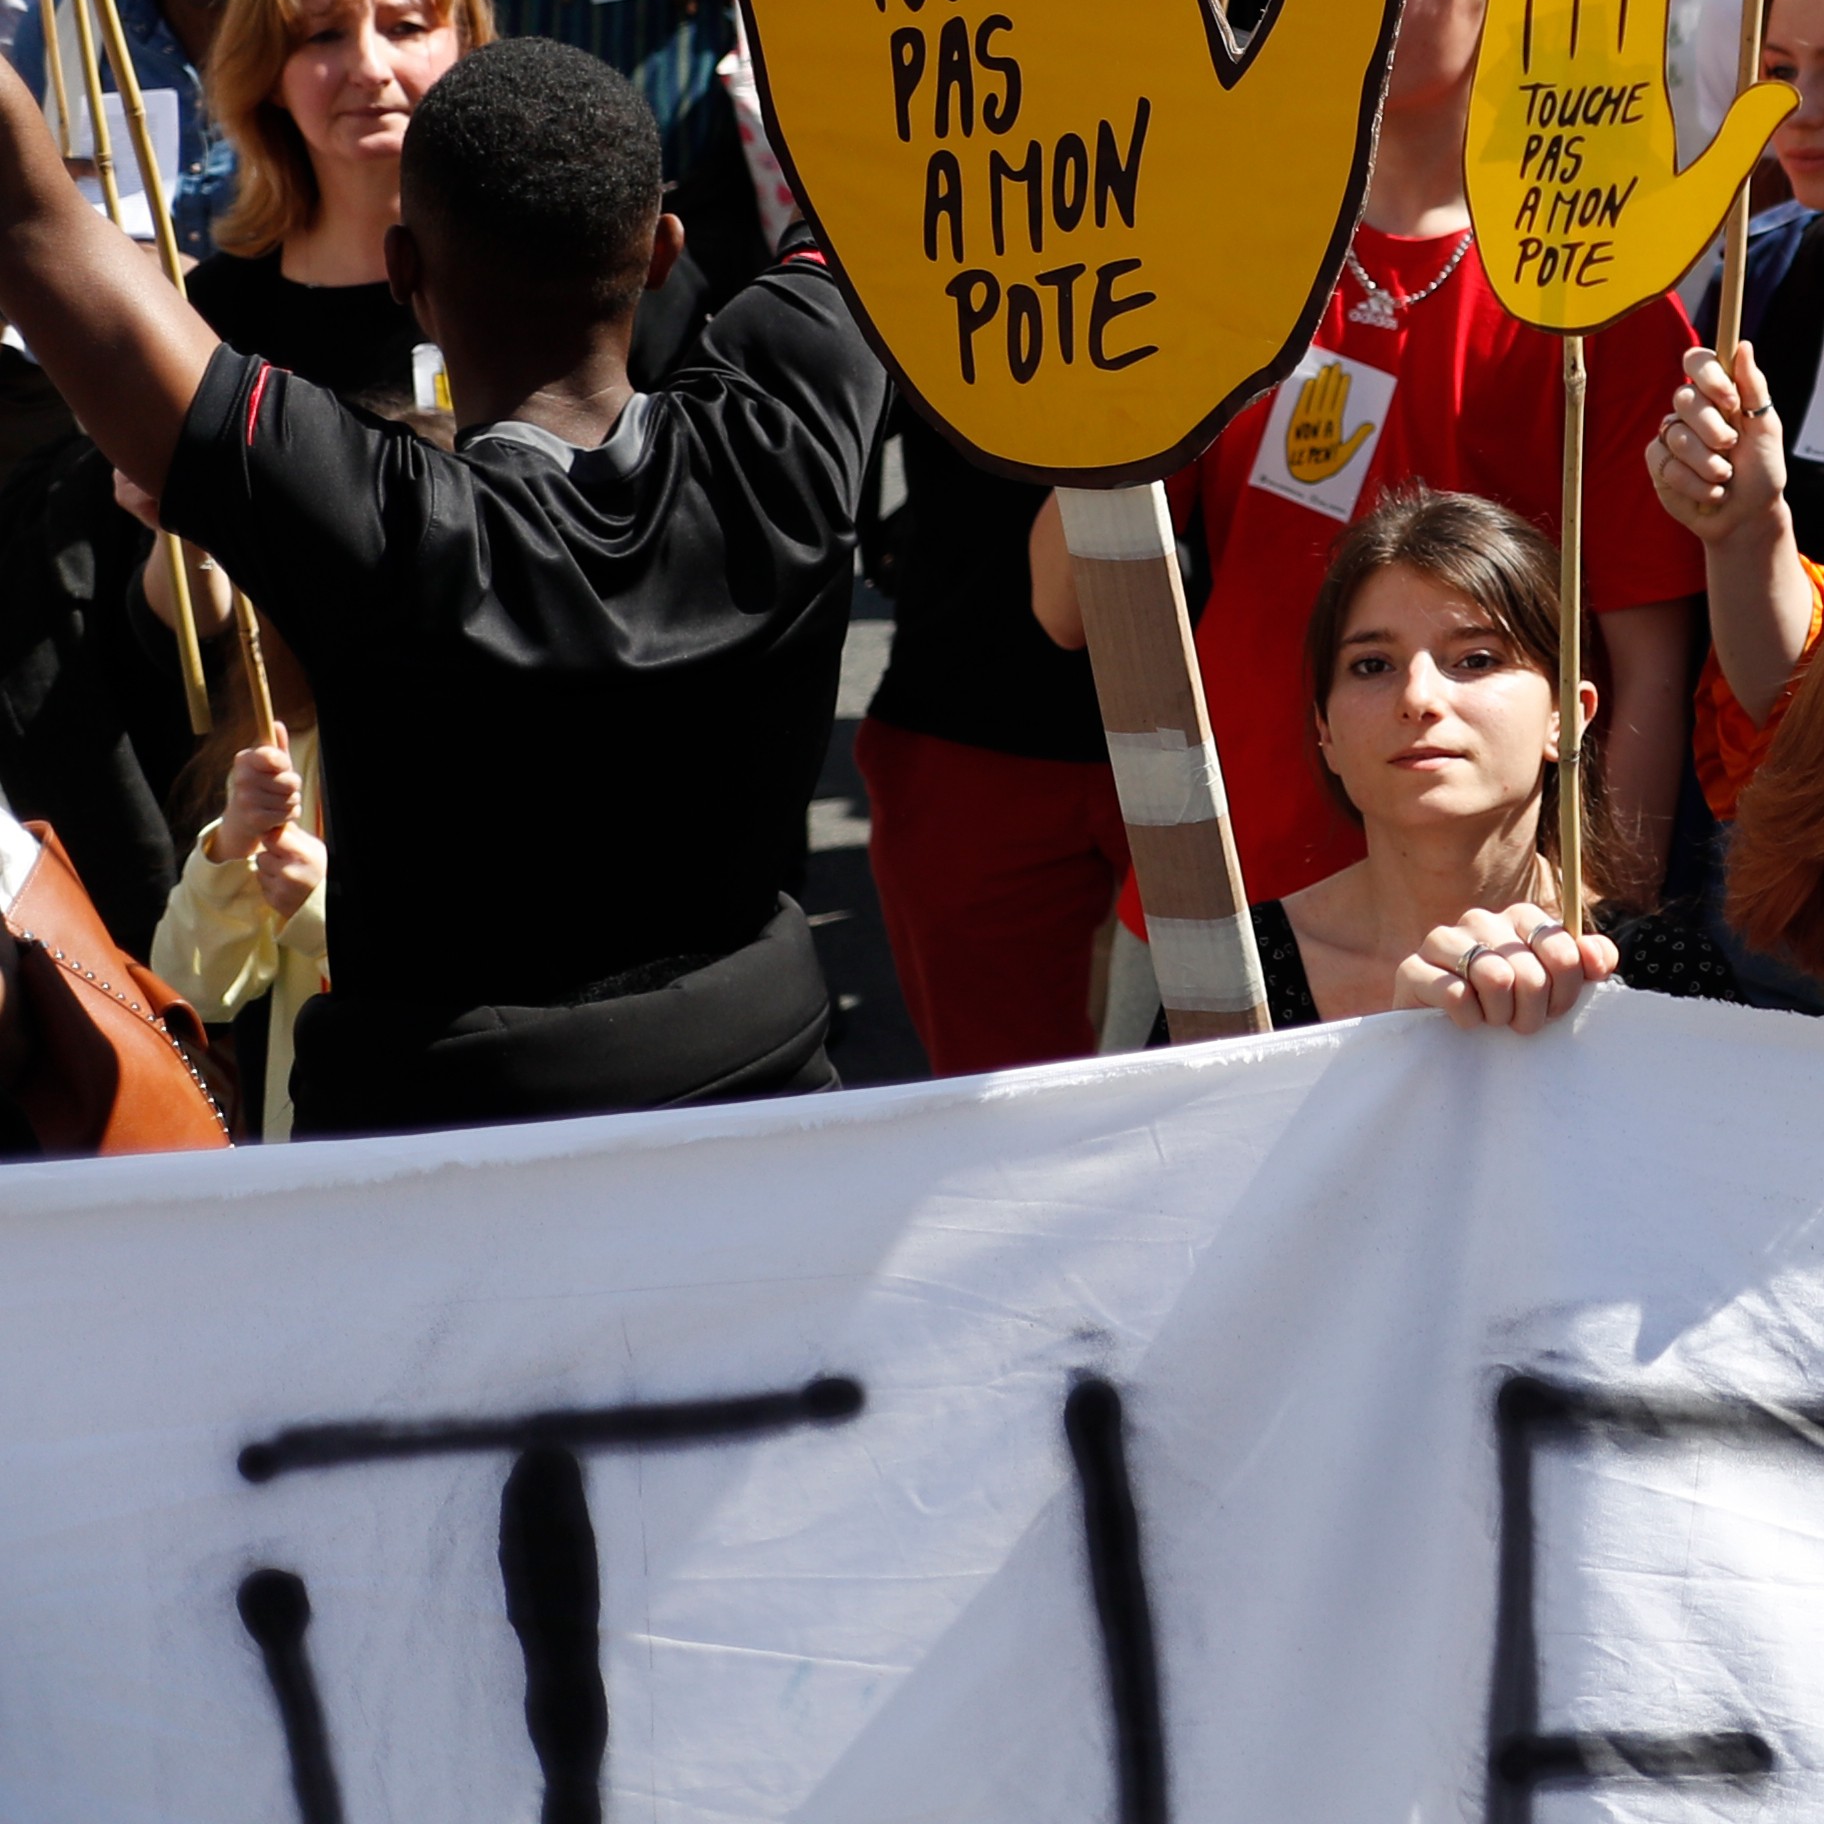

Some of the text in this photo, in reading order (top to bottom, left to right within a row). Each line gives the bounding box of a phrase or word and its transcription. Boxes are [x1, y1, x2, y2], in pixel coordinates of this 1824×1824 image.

[890, 15, 1022, 142] PAS
[1519, 82, 1650, 130] TOUCHE
[923, 97, 1151, 263] A MON
[1520, 135, 1583, 181] PAS
[1515, 176, 1639, 236] A MON
[1514, 241, 1615, 289] POTE
[946, 257, 1159, 384] POTE
